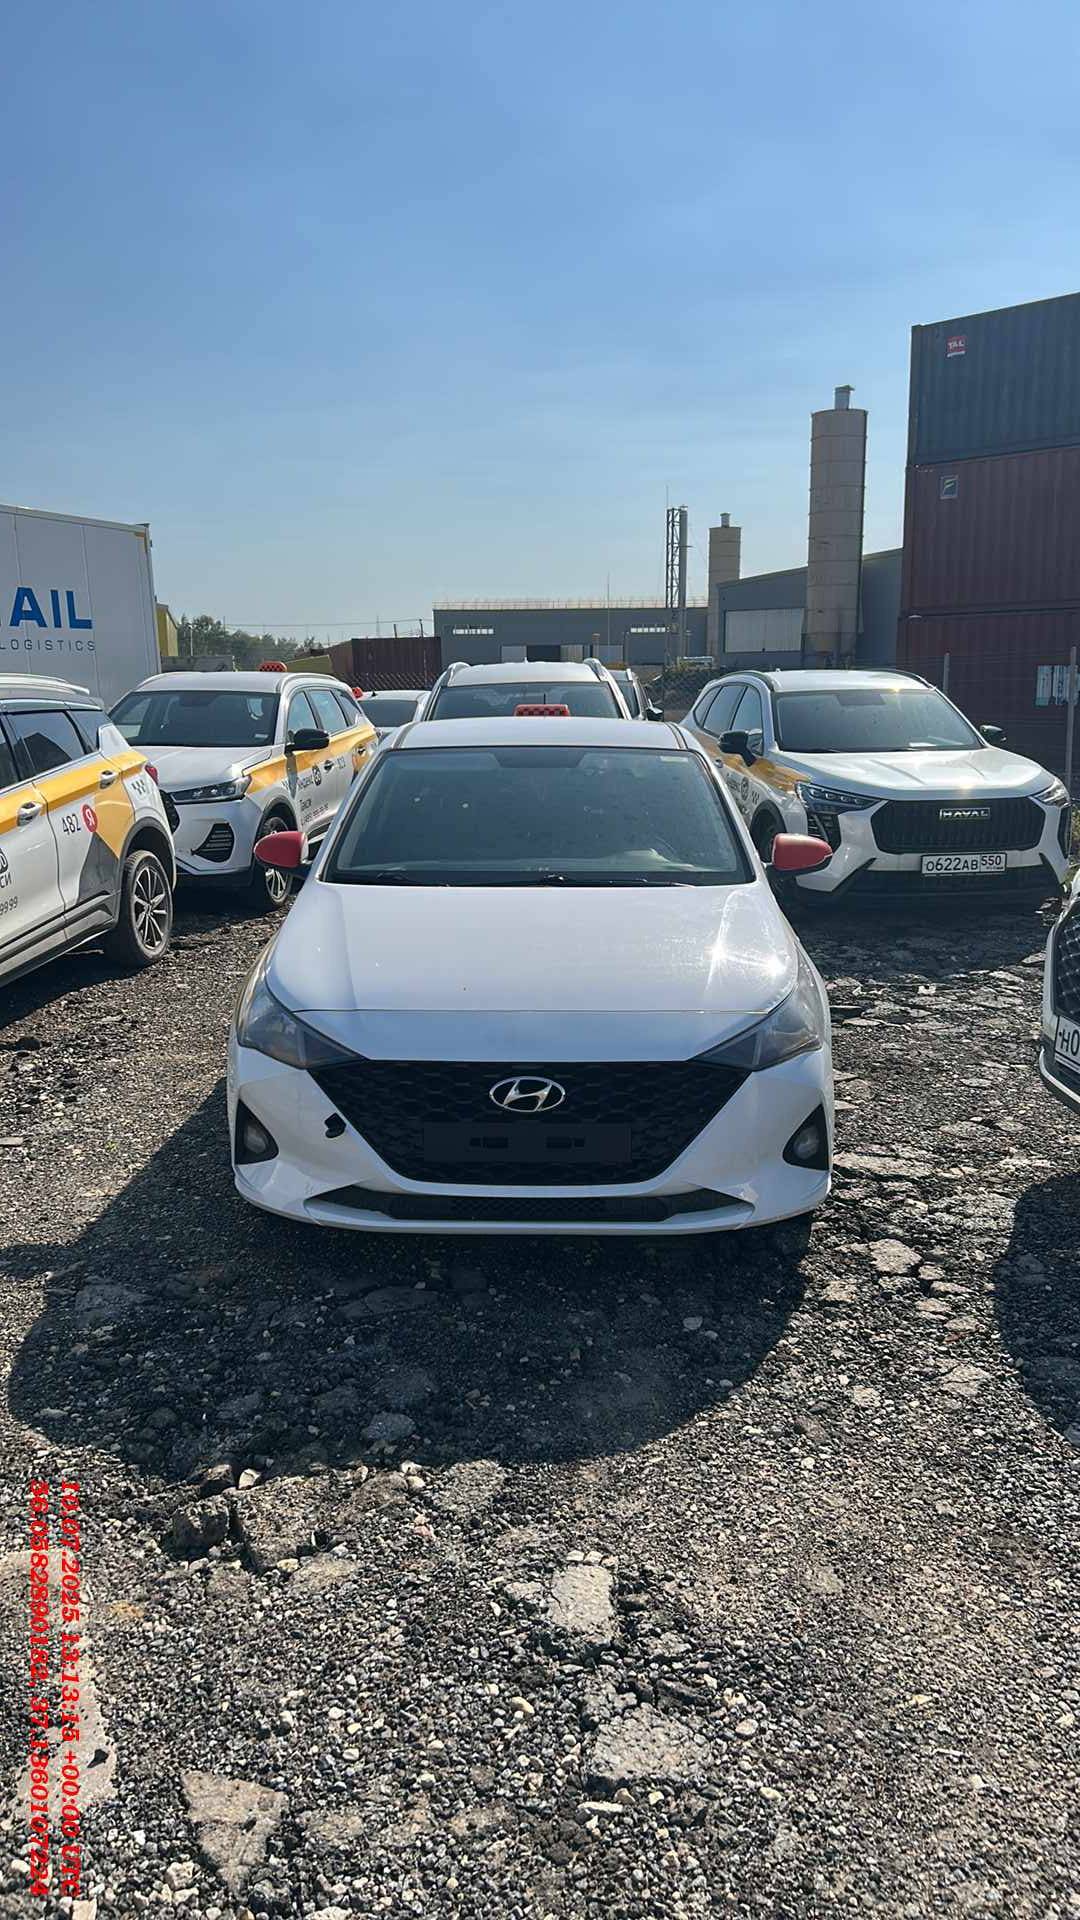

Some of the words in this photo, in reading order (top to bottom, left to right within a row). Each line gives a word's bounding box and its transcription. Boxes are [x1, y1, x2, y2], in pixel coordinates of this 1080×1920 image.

[0, 586, 93, 630] AIL
[0, 638, 96, 652] LOGISTICS
[941, 810, 989, 818] HAVAL
[62, 814, 81, 834] 482
[981, 855, 1002, 866] 550
